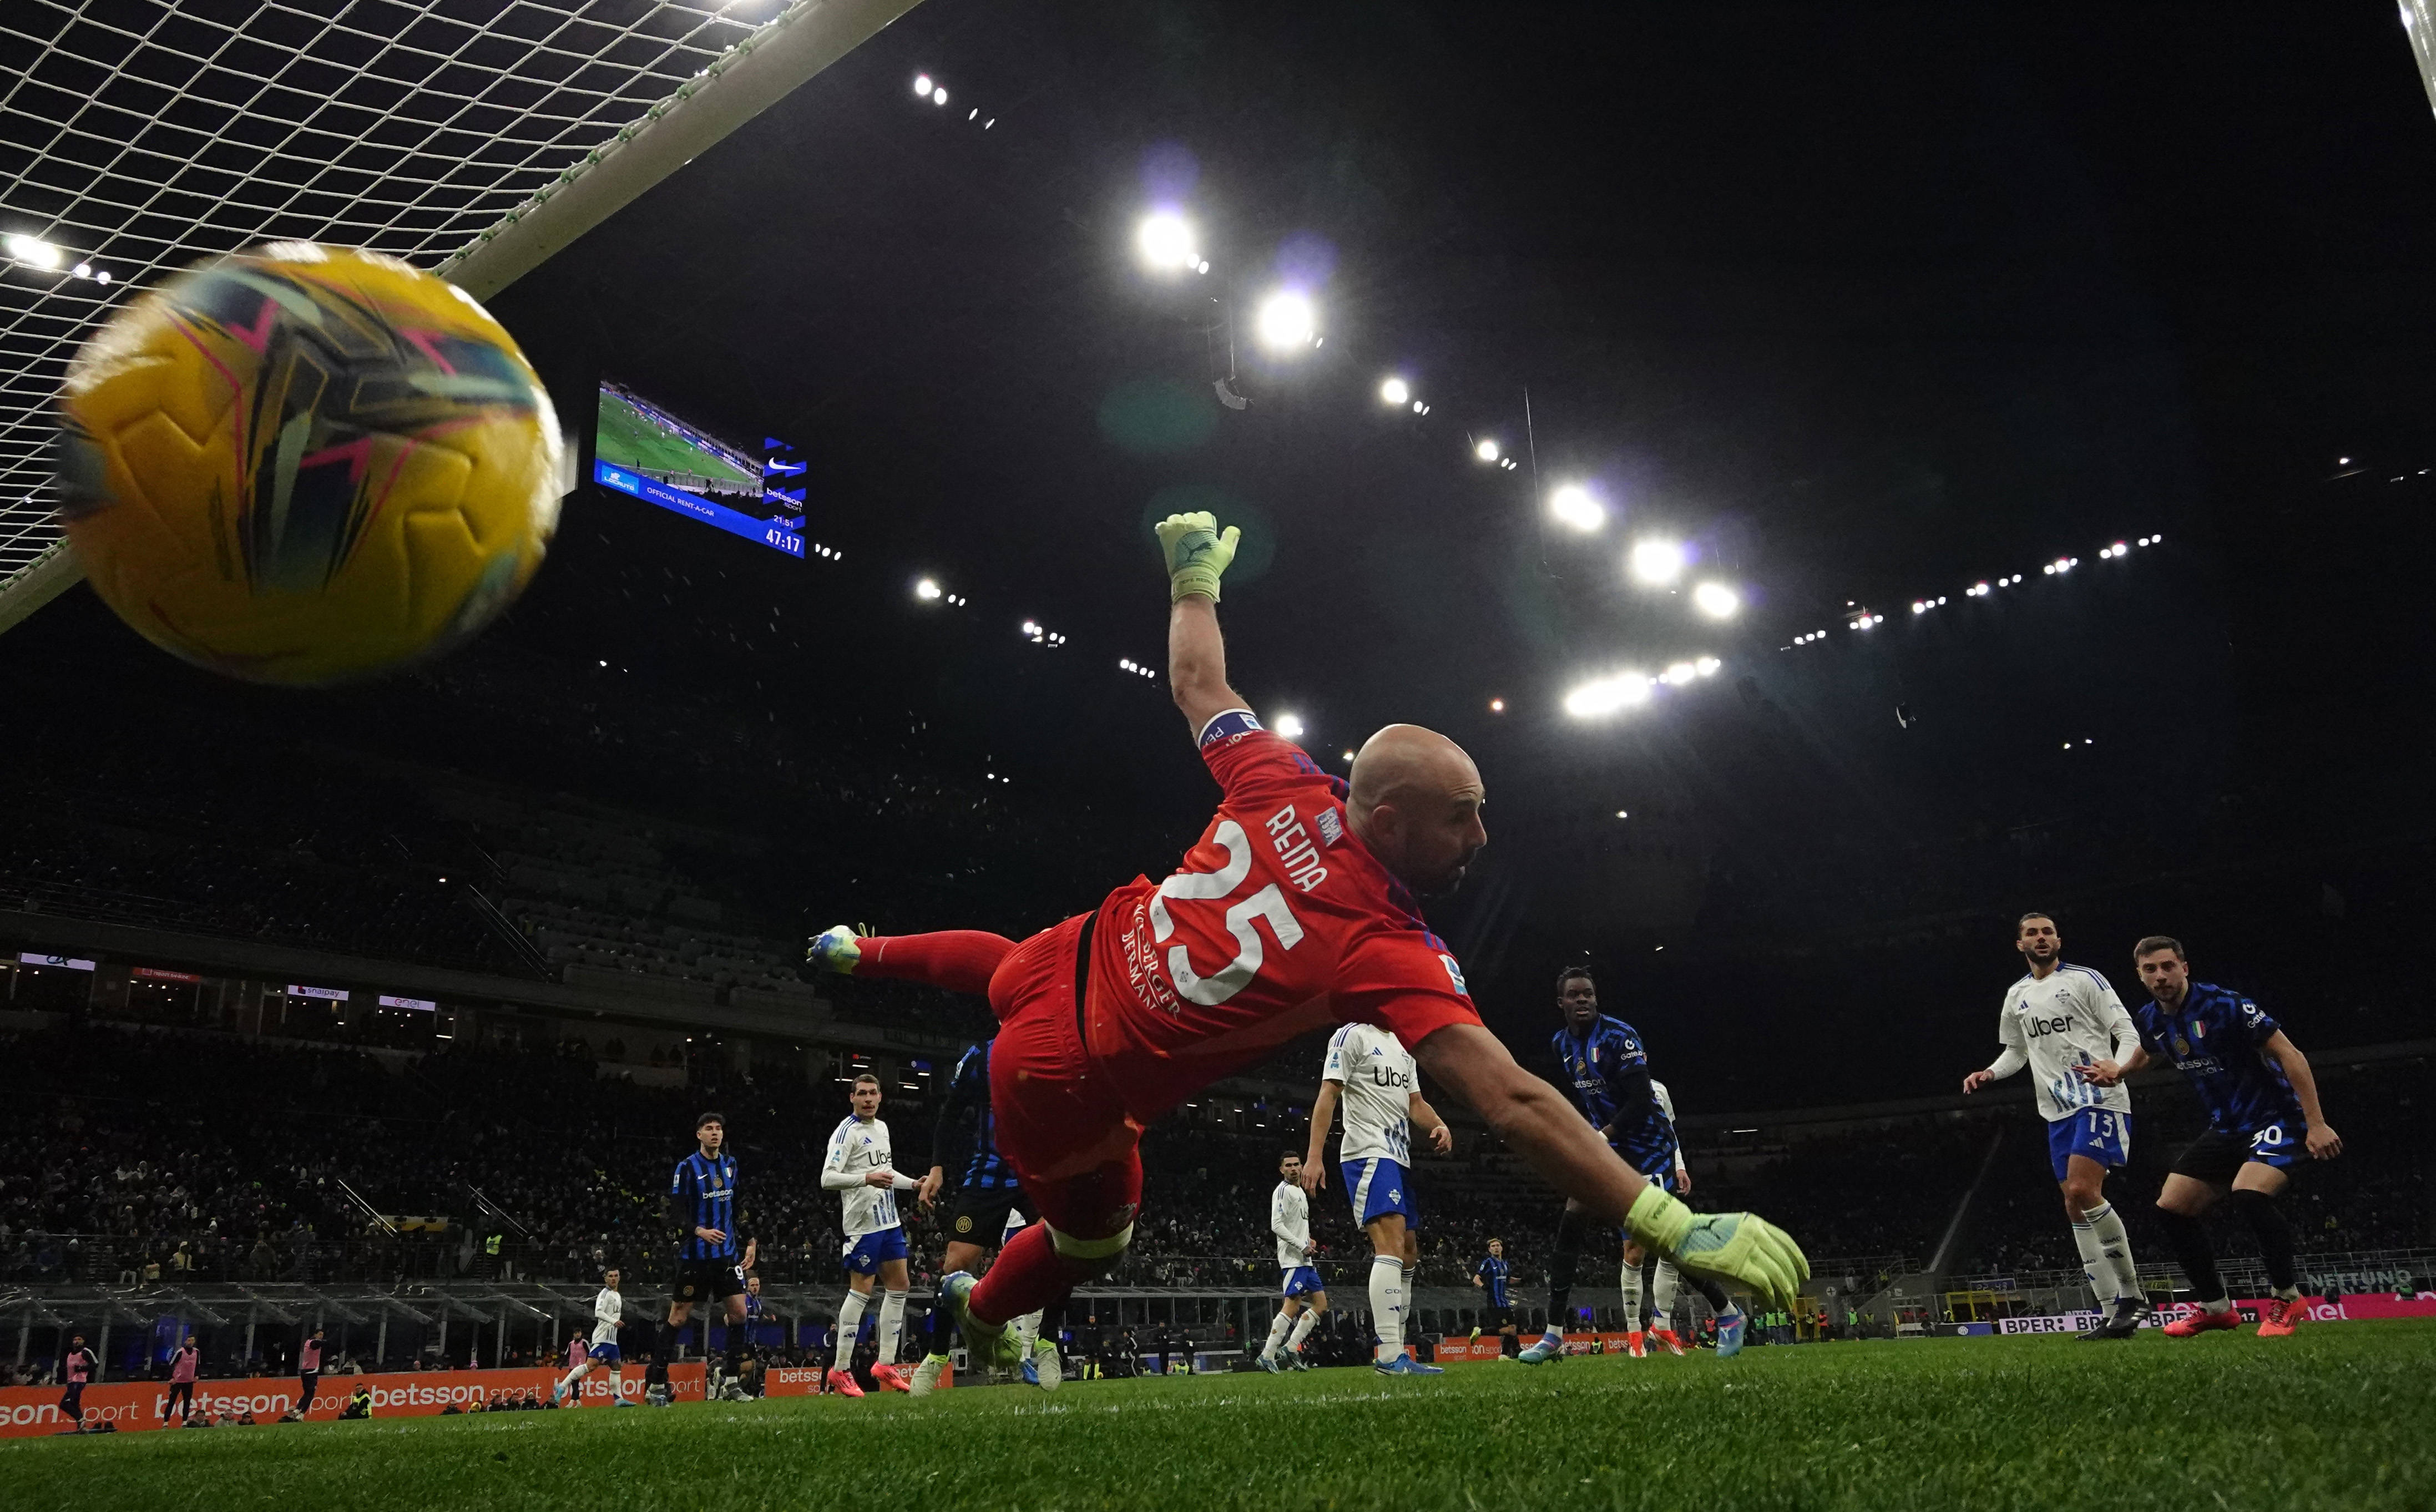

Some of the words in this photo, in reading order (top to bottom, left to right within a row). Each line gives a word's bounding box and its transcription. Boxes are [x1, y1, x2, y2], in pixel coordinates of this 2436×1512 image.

[604, 476, 635, 491] LOCAUTO
[647, 487, 676, 503] OFFICIAL
[677, 498, 715, 517] RENT-A-CAR
[766, 487, 802, 507] betsson
[774, 514, 794, 528] 21:51
[766, 528, 800, 552] 47:17
[1265, 804, 1328, 892] REINA
[1149, 819, 1305, 1006] 25
[1121, 929, 1157, 1010] BERMAN
[307, 987, 340, 998] snaipay
[395, 998, 421, 1009] enel
[2023, 1015, 2074, 1039] Uber
[2088, 1111, 2113, 1137] 13
[2249, 1125, 2283, 1149] 30
[702, 1189, 734, 1199] betsson
[2241, 1312, 2256, 1321] 17
[1440, 1345, 1467, 1354] betsson
